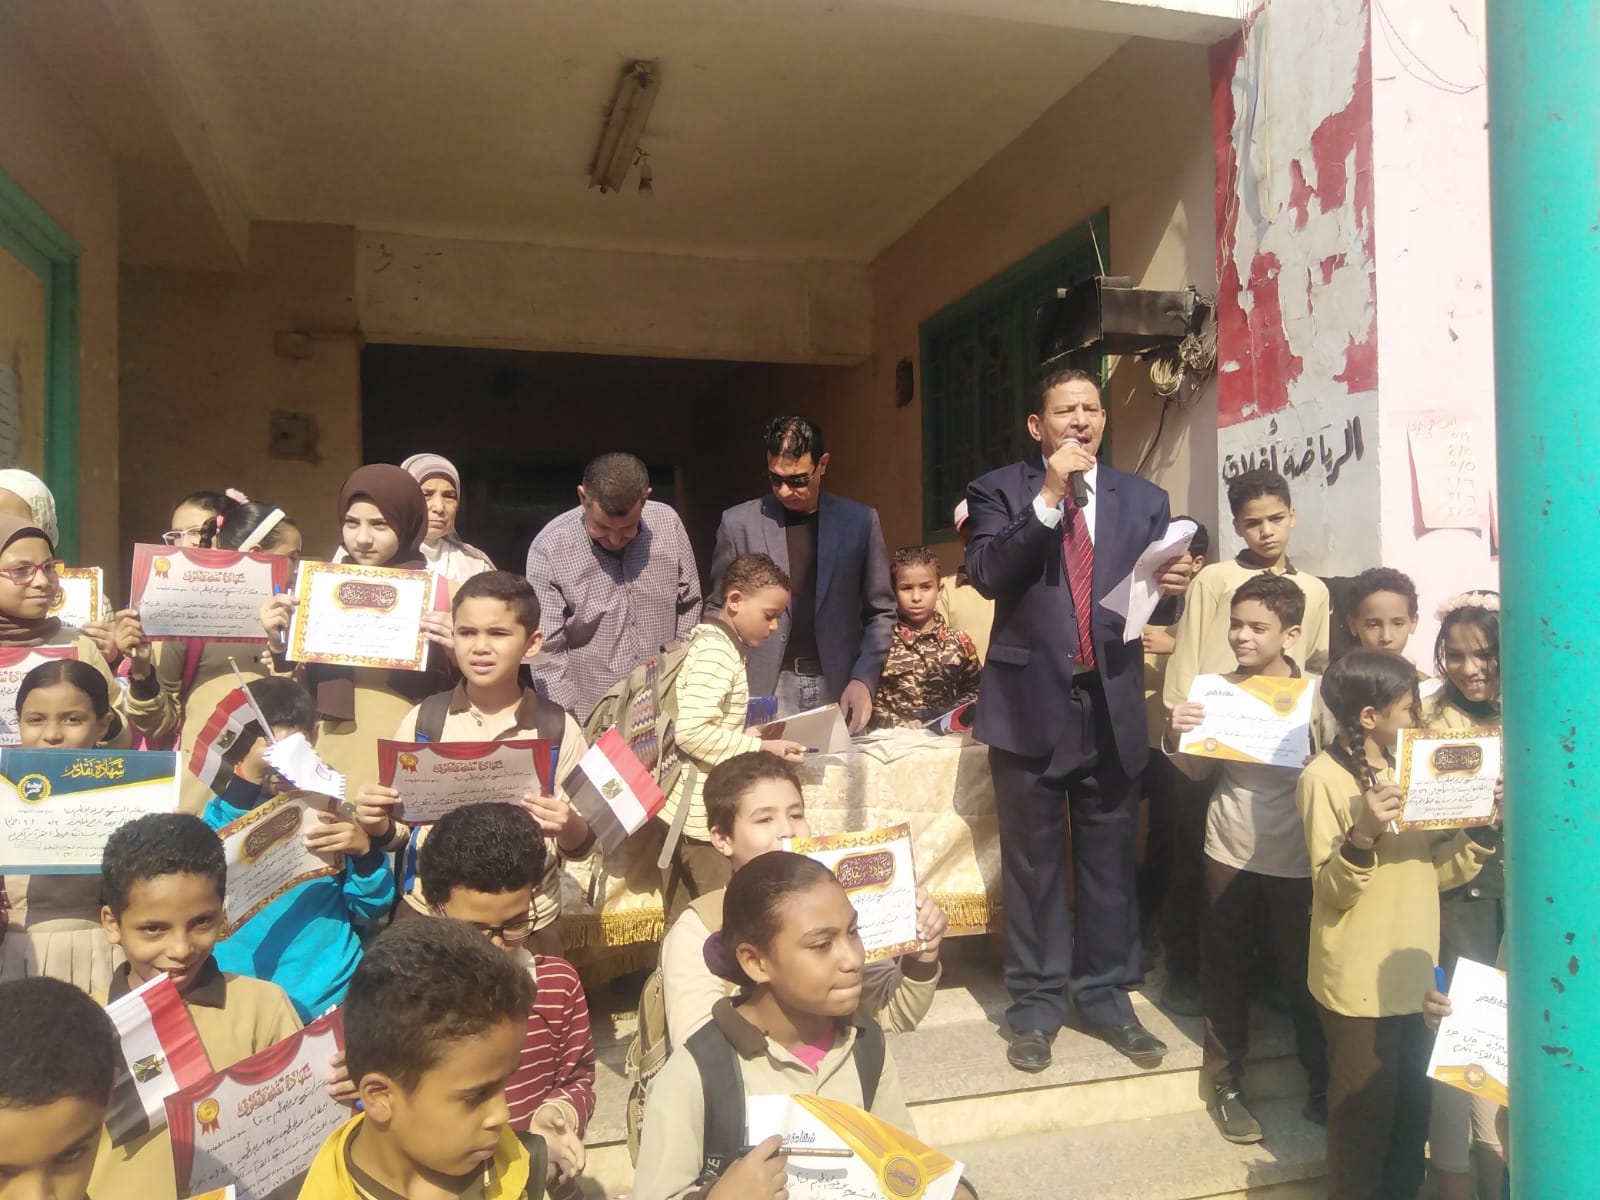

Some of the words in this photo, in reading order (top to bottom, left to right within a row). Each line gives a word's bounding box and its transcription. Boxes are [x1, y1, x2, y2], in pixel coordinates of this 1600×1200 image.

[1283, 415, 1365, 487] الرياضة
[61, 758, 95, 778] تقدير
[95, 757, 125, 779] شهادة
[790, 1130, 816, 1144] شهادة
